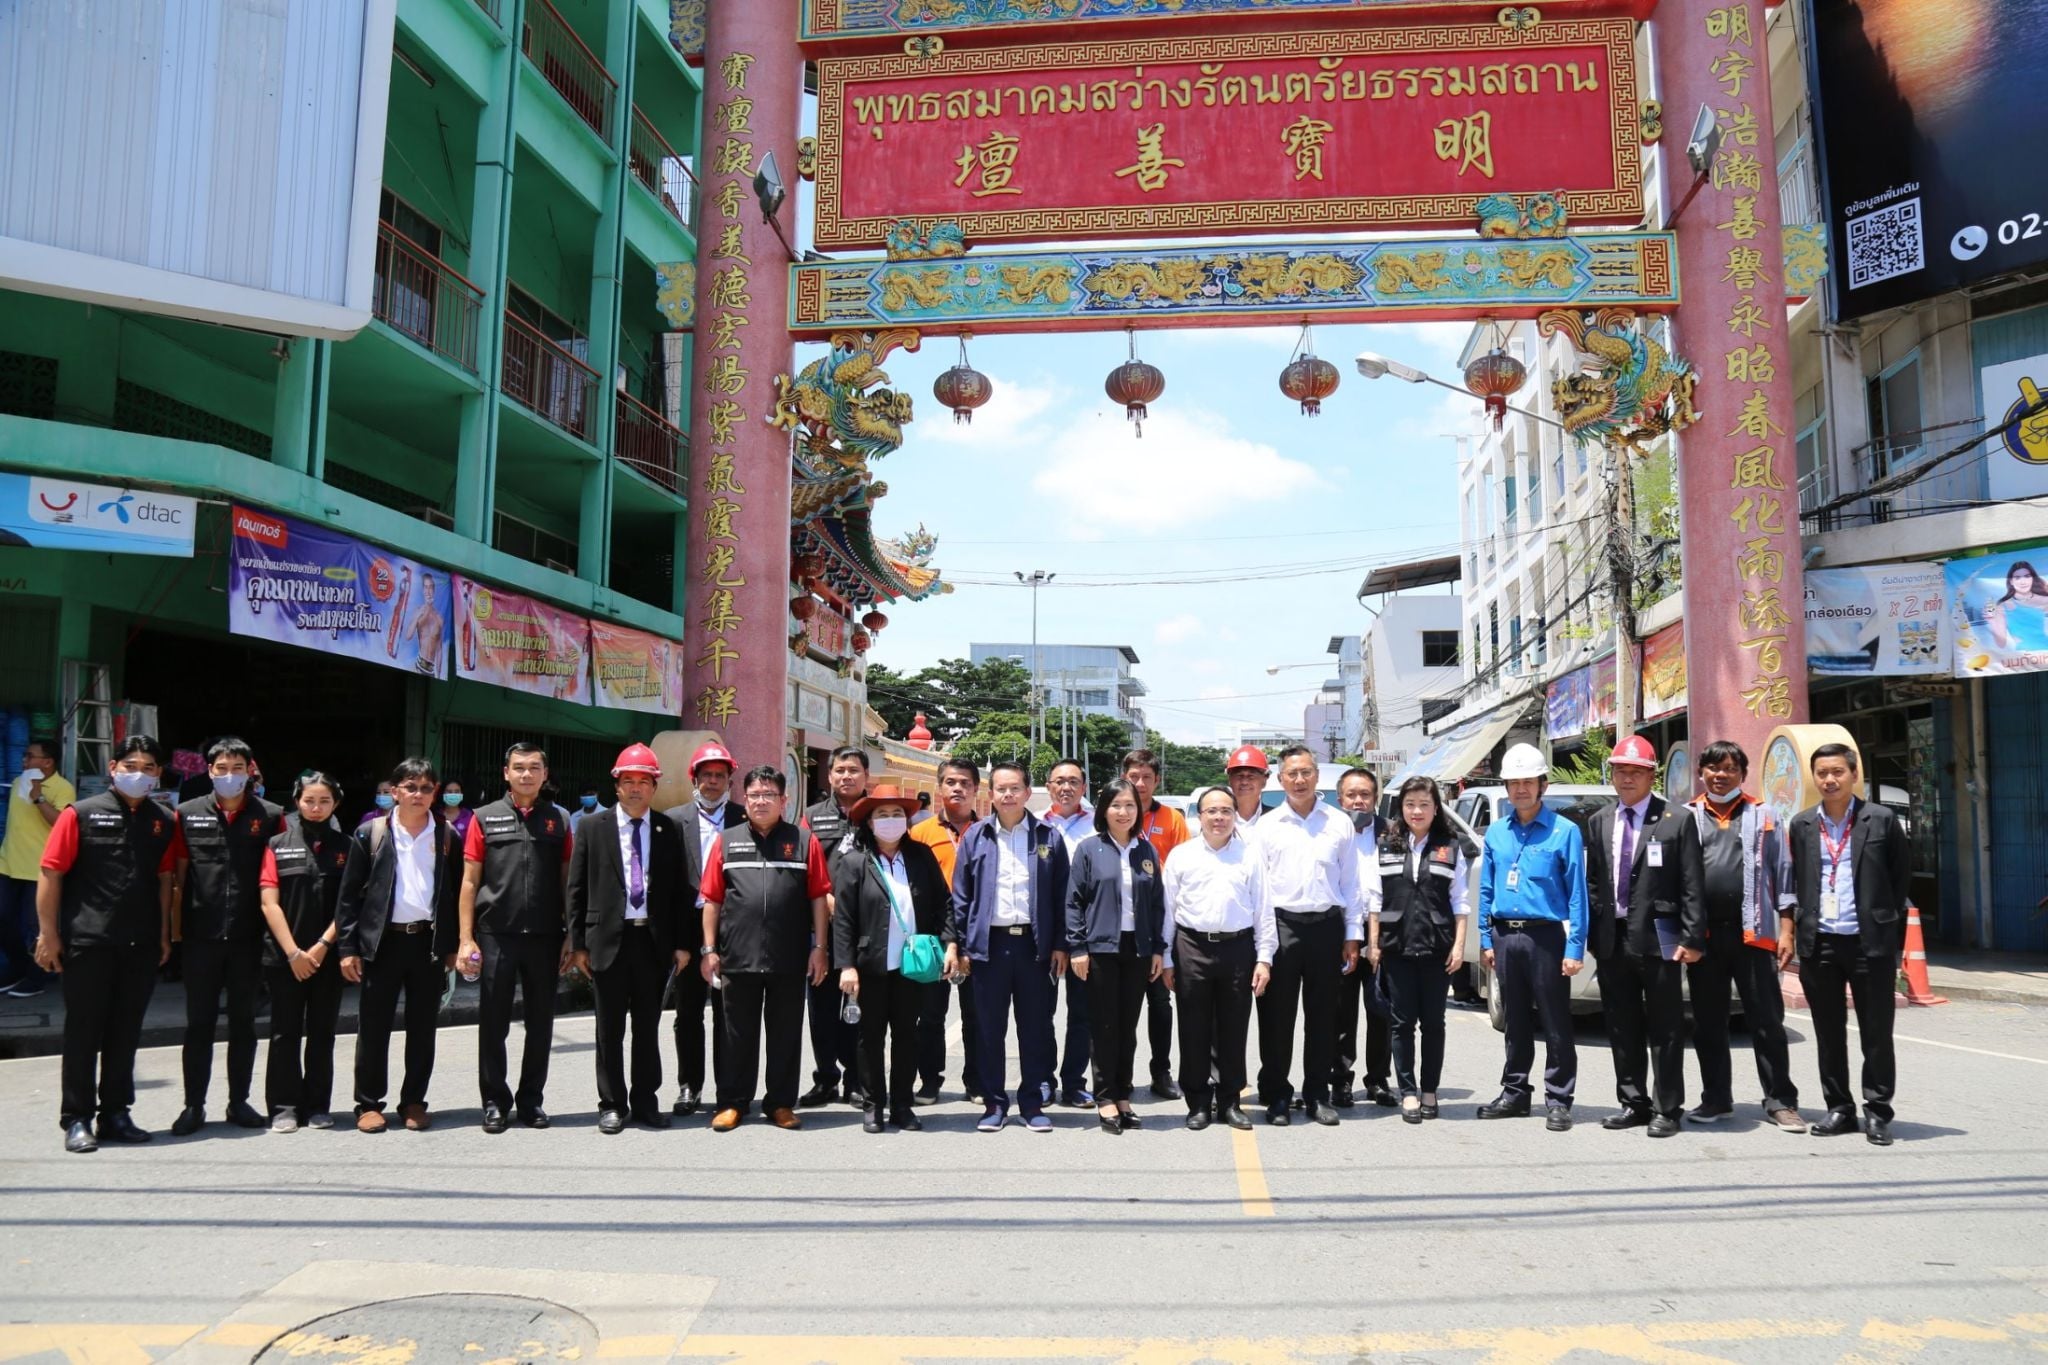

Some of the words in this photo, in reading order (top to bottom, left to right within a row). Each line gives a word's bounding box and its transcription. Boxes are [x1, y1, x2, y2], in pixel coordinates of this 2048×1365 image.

[853, 56, 1599, 141] พุทธสมาคมสว่างรัตนตรัยธรรมสถาน
[1844, 181, 1920, 217] ดูข้อมูลเพิ่มเติม
[137, 501, 182, 525] dtac
[376, 568, 389, 581] 22
[1903, 596, 1920, 618] 2
